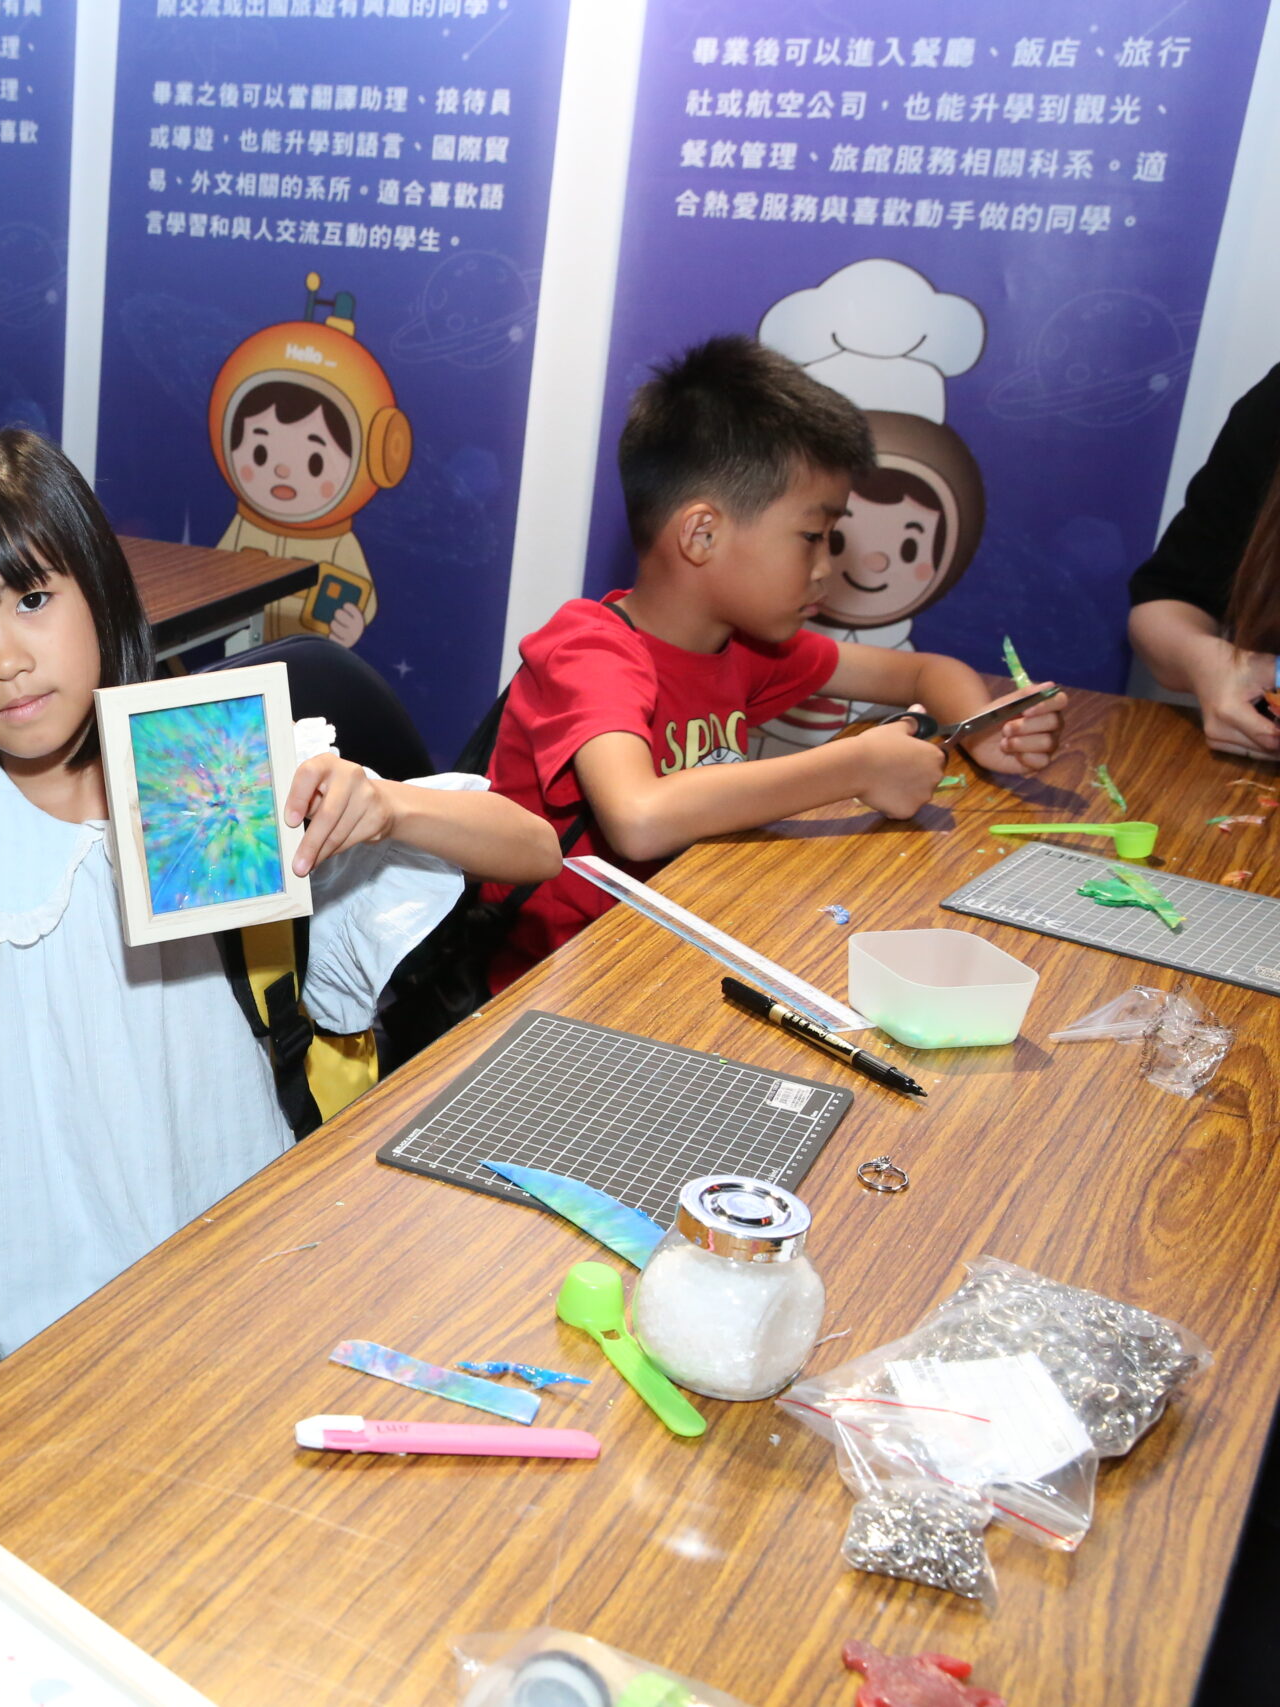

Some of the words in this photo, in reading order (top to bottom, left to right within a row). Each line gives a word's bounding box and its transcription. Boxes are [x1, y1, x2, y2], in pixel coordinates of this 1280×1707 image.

[692, 36, 1191, 69] 畢業後可以進入餐廳、飯店、旅行
[152, 81, 512, 116] 畢業之後可以當翻譯助理、接待員
[685, 90, 1169, 125] 社或航空公司，也能升學到觀光、
[149, 125, 510, 164] 或導遊，也能升學到語言、國際貿
[679, 139, 1168, 183] 餐飲管理、旅館服務相關科系。適
[148, 168, 504, 211] 易、外文相關的系所。適合喜歡語
[145, 210, 460, 253] 言學習和與人交流互動的學生。
[675, 189, 1137, 235] 合熱愛服務與喜歡動手做的同學。
